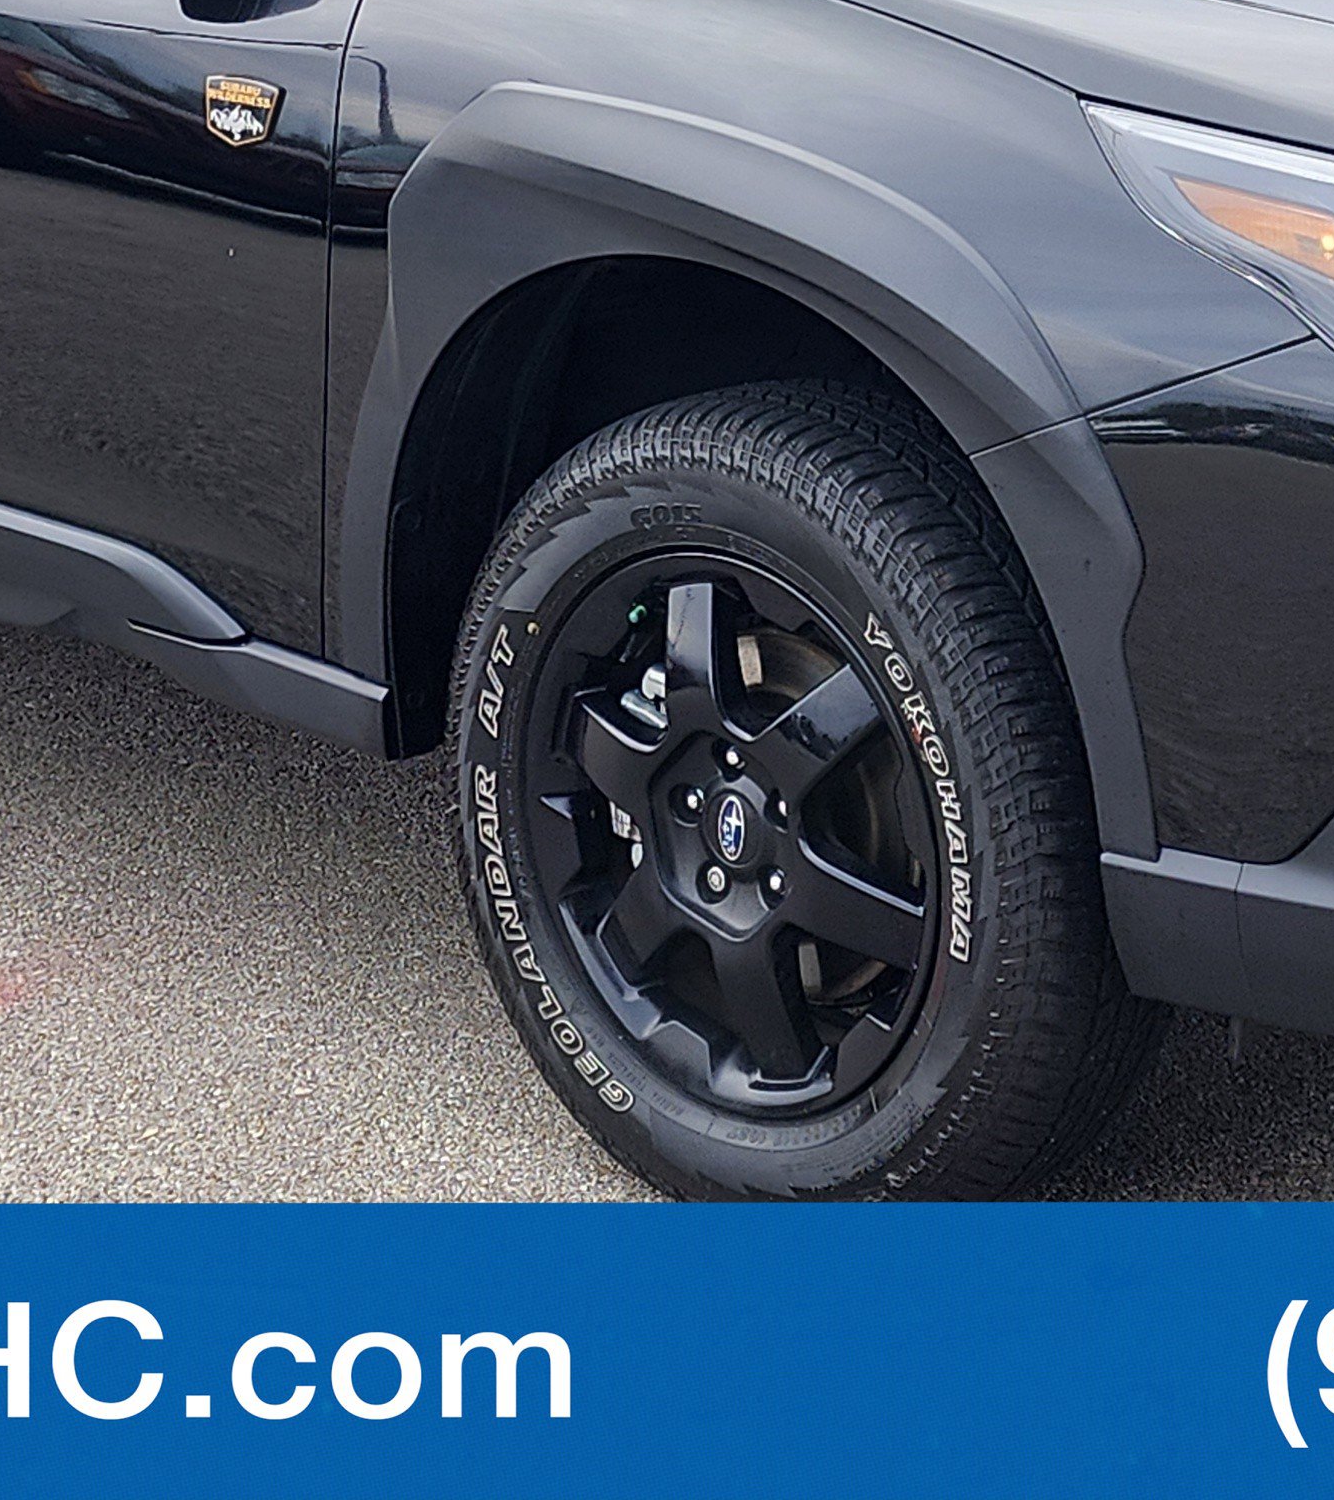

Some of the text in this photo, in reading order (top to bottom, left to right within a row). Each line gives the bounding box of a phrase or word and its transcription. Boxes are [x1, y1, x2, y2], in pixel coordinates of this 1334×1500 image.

[477, 623, 515, 739] A/T
[863, 611, 973, 963] YOKOHAMA
[474, 763, 635, 1113] GEOLANDAR
